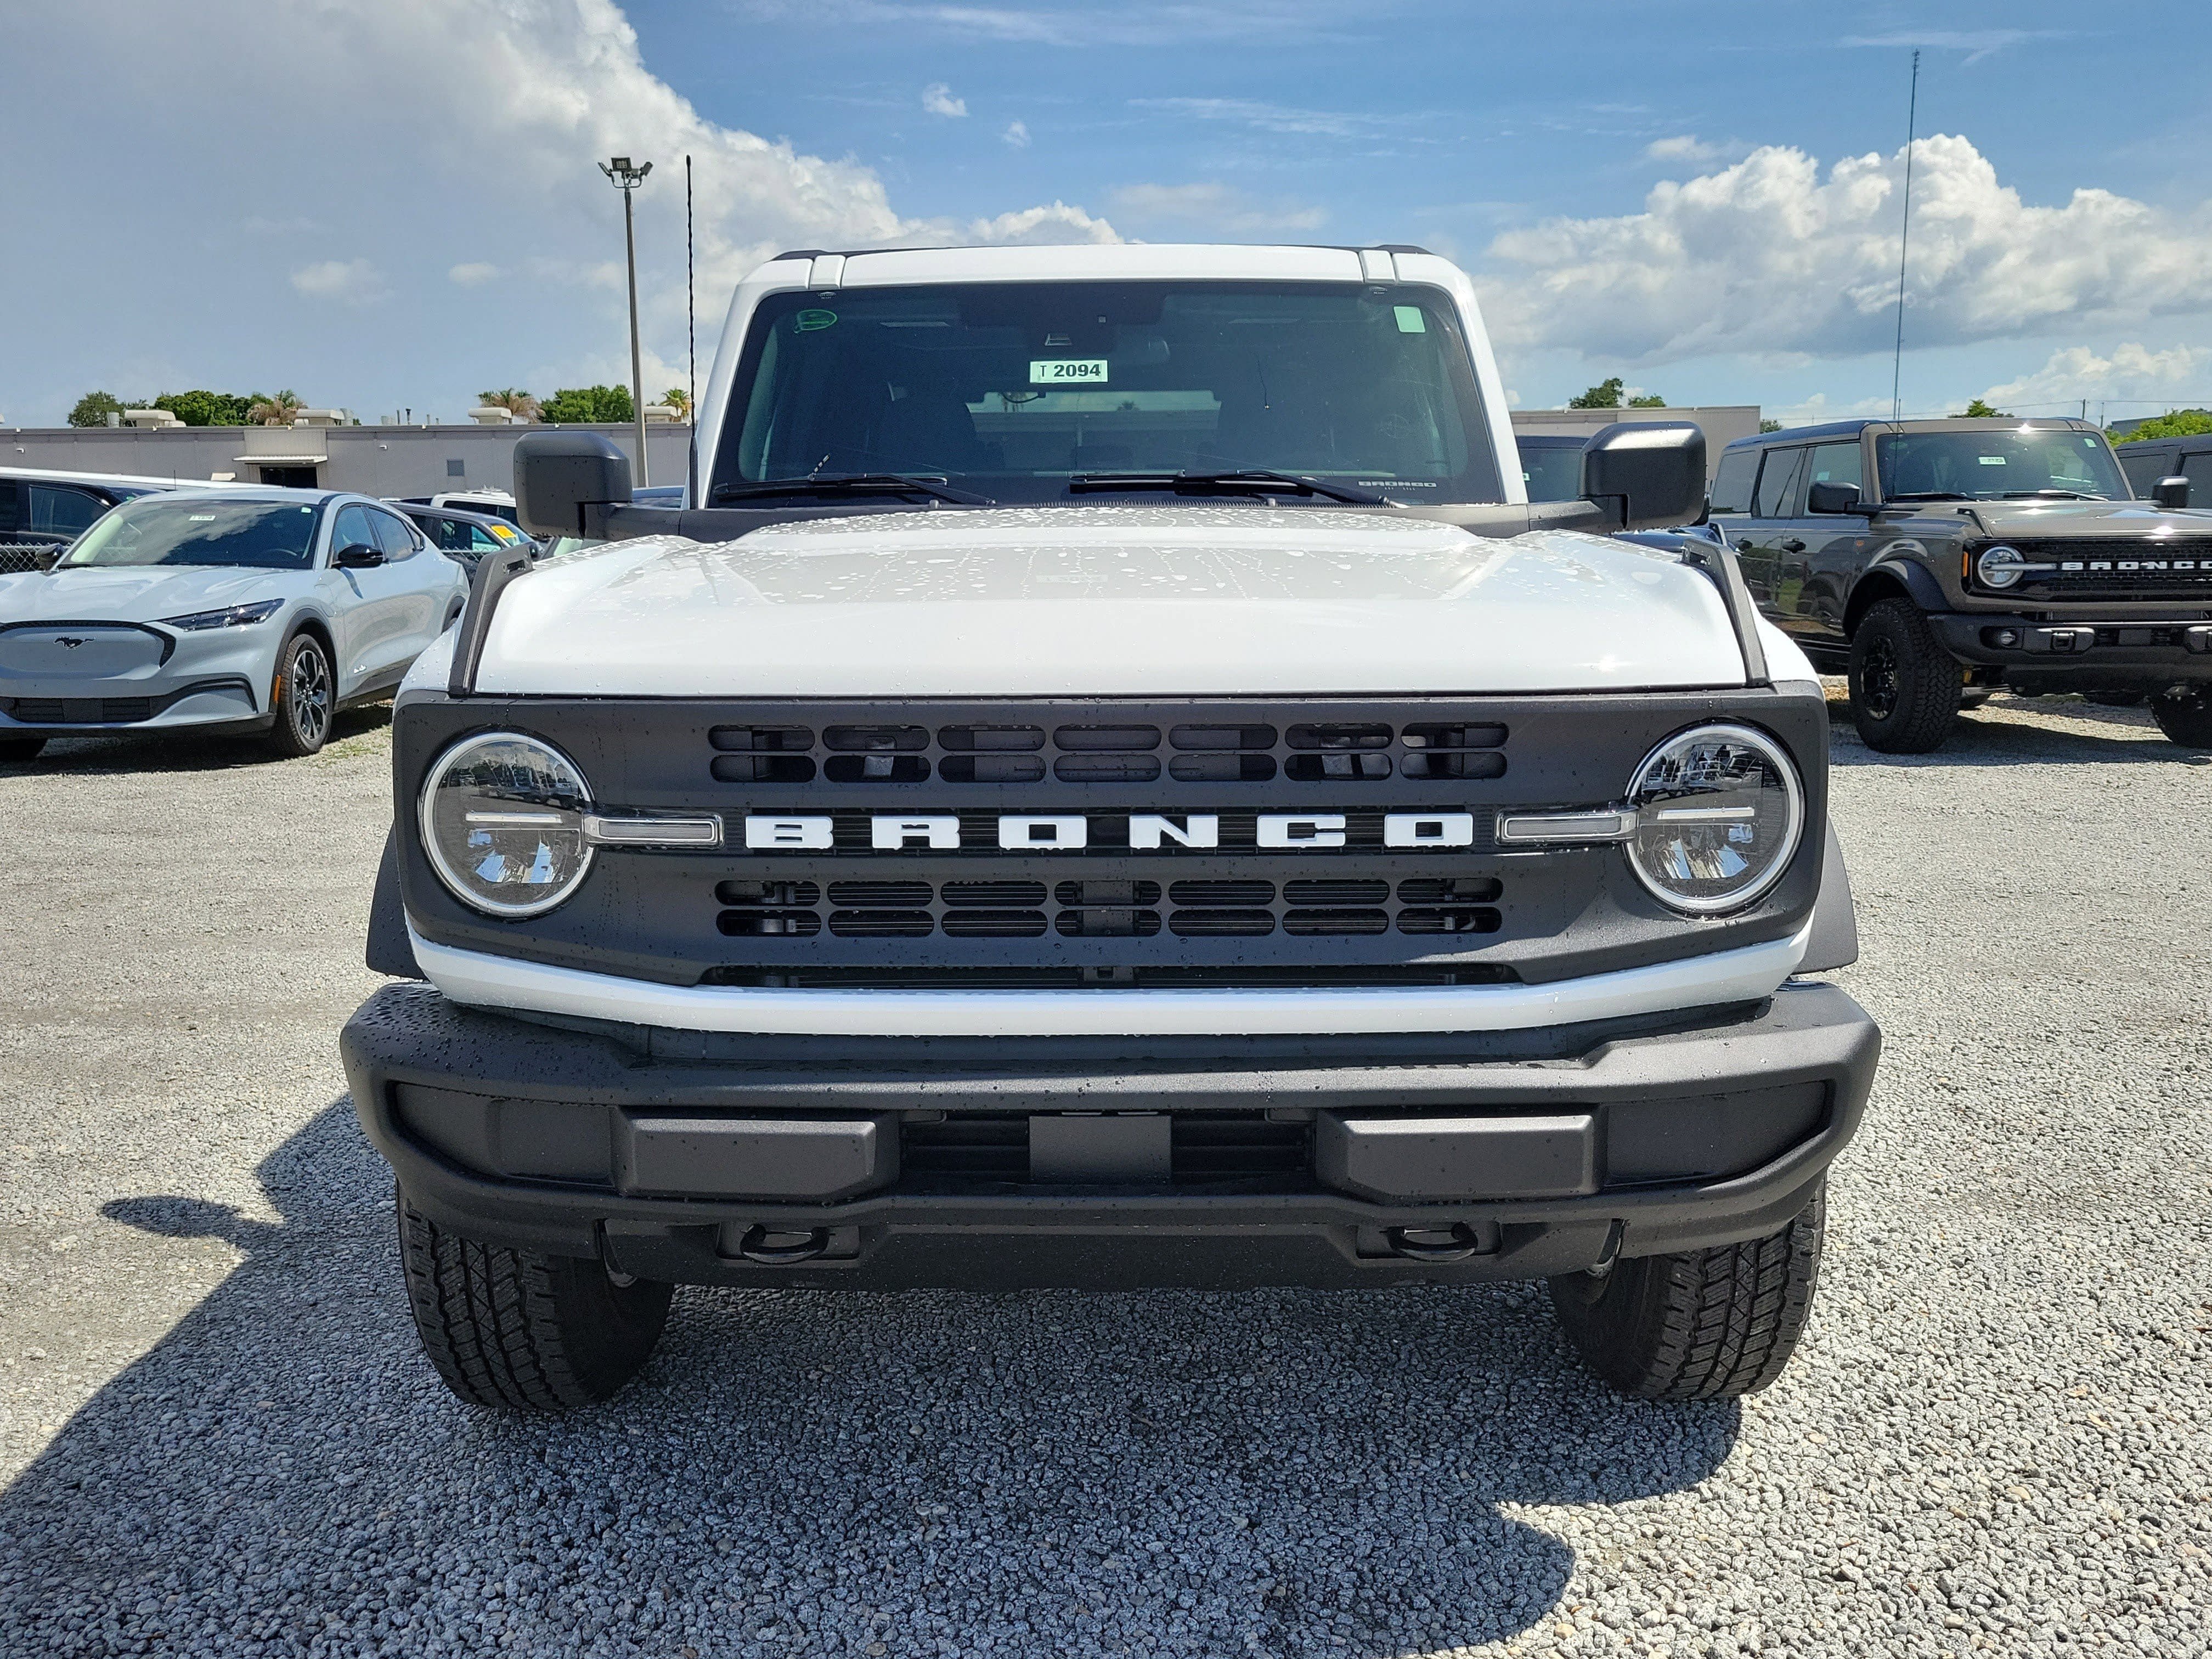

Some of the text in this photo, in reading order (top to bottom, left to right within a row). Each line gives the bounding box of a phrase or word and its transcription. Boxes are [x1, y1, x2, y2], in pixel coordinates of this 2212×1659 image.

[1040, 364, 1101, 377] T 2094
[746, 813, 1473, 849] BRONCO
